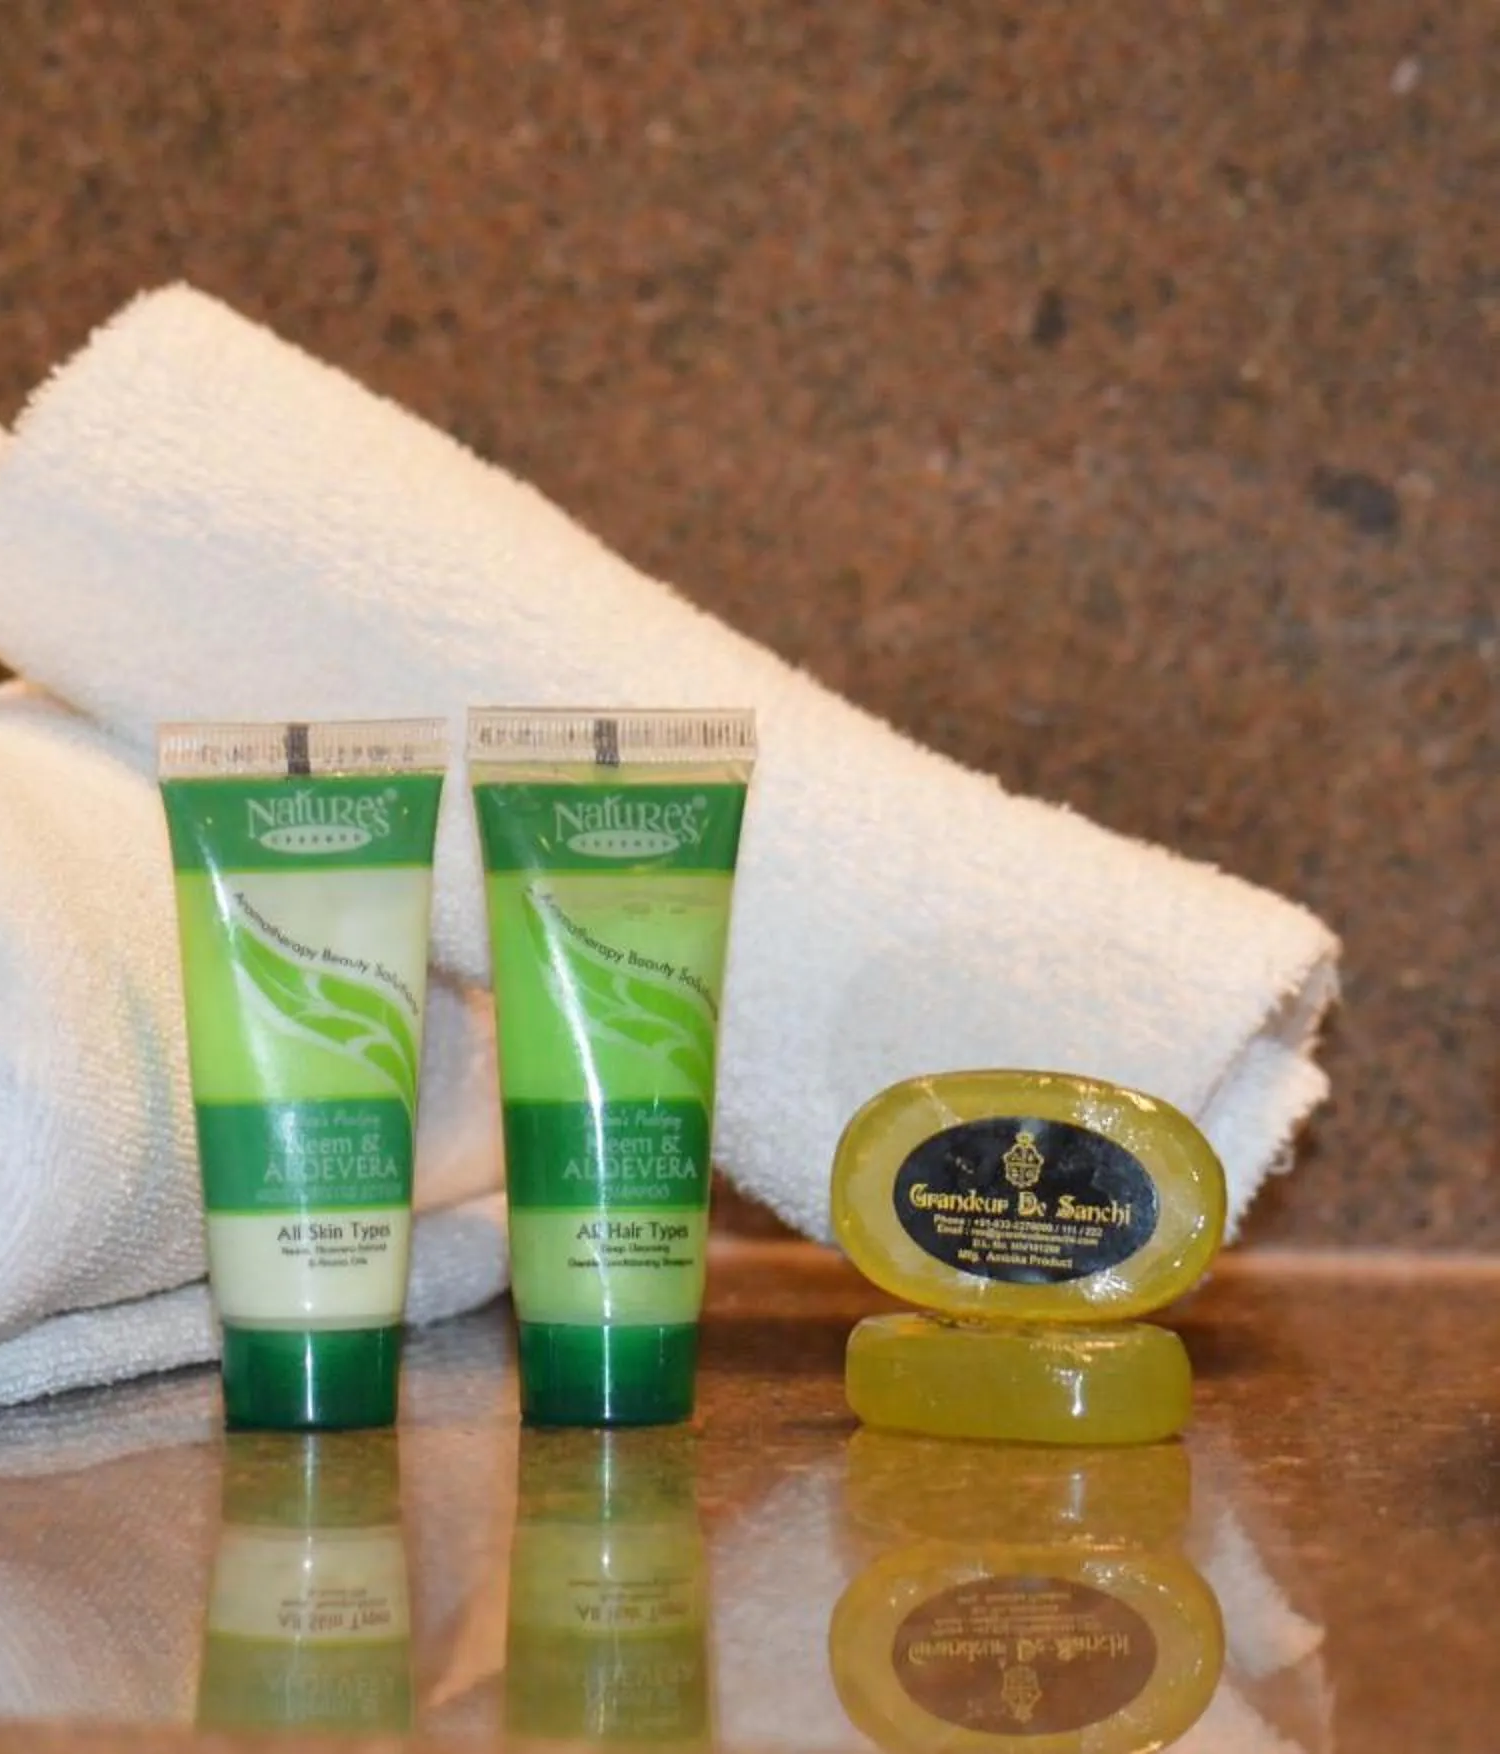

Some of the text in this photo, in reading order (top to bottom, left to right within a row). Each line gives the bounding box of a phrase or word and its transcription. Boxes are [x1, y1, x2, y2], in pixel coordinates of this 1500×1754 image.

[233, 892, 319, 961] Aromatherapy
[322, 944, 370, 974] Beauty
[627, 949, 676, 981] Beauty
[286, 1133, 382, 1155] Neem &
[661, 1135, 682, 1154] &
[562, 1156, 698, 1181] ALOEVERA
[909, 1183, 1009, 1214] Grandeur
[1018, 1191, 1047, 1217] De
[1056, 1194, 1132, 1227] Sanchi
[277, 1221, 390, 1241] All Skin Types
[607, 1222, 644, 1240] Hair
[649, 1221, 689, 1242] Types
